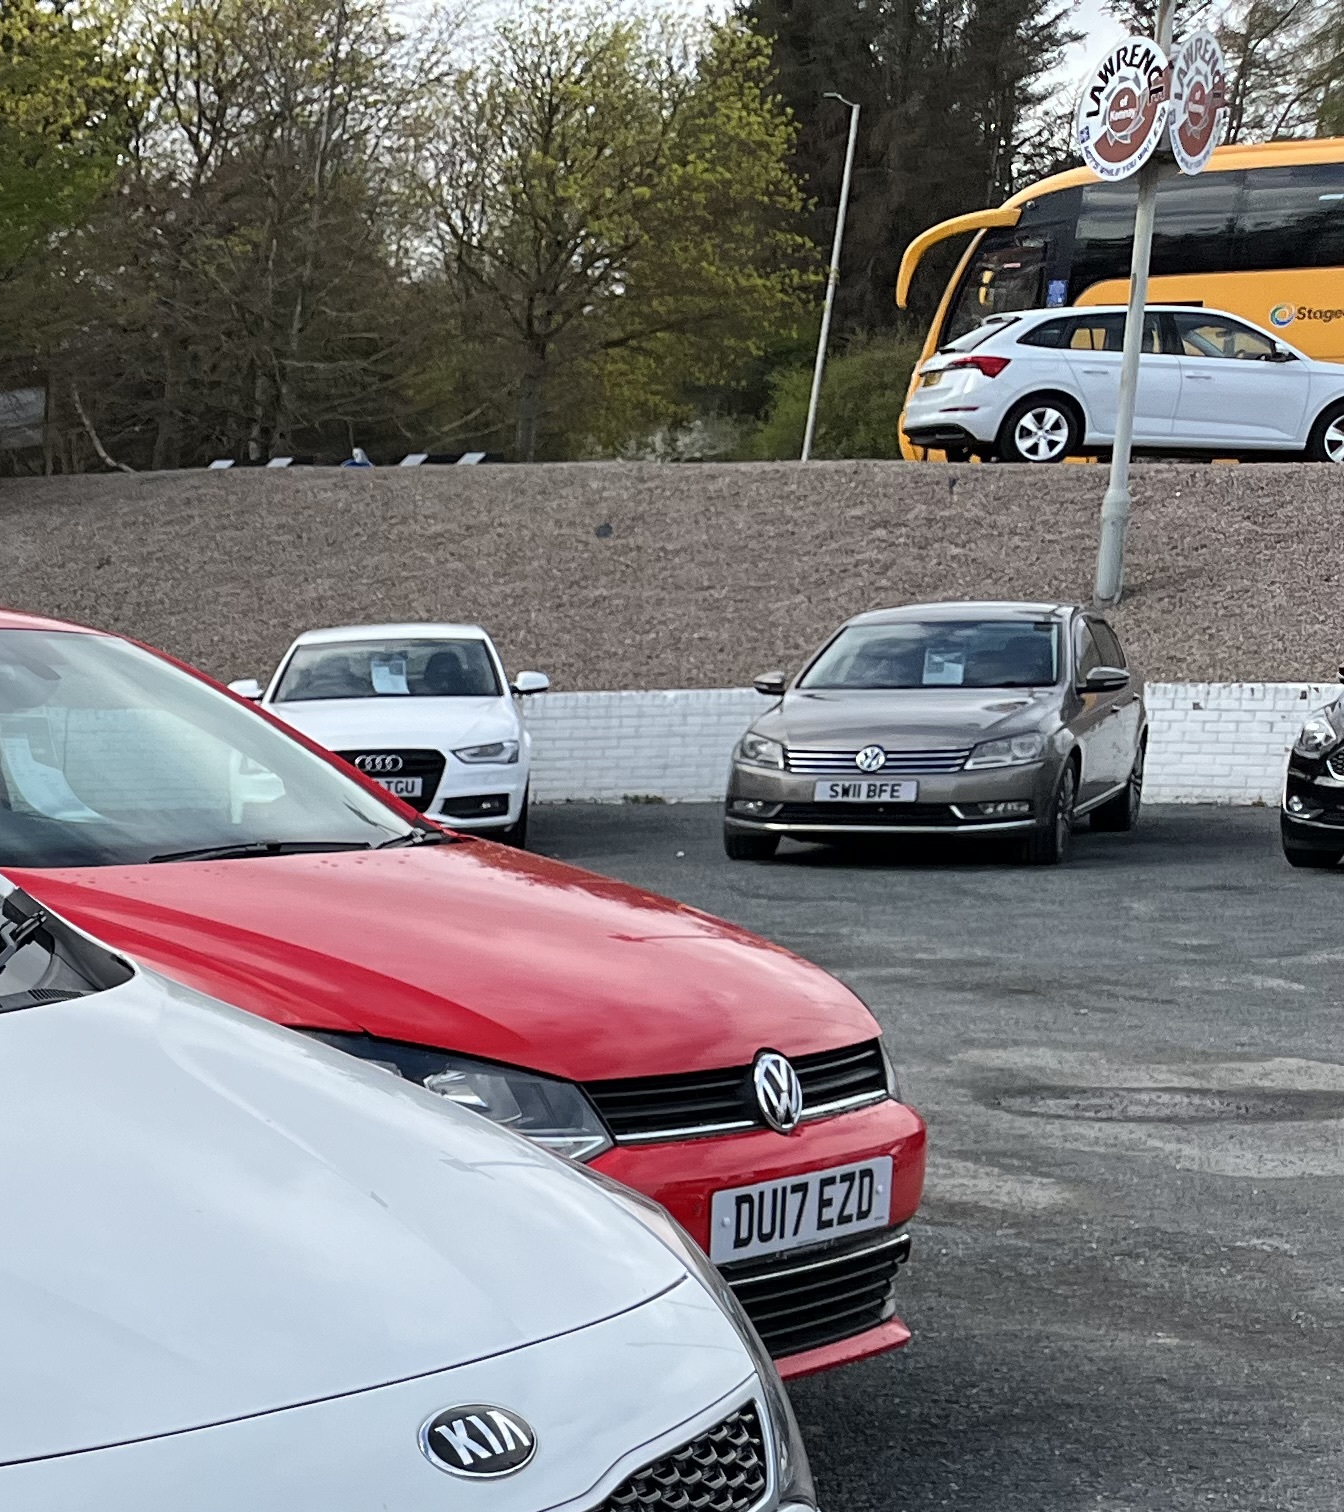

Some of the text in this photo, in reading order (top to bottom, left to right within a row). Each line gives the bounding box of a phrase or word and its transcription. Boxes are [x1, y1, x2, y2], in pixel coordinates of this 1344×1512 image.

[1295, 306, 1344, 323] Stage
[866, 783, 902, 799] BFE
[733, 1168, 875, 1250] DU17 EZD
[434, 1410, 531, 1467] KIA
